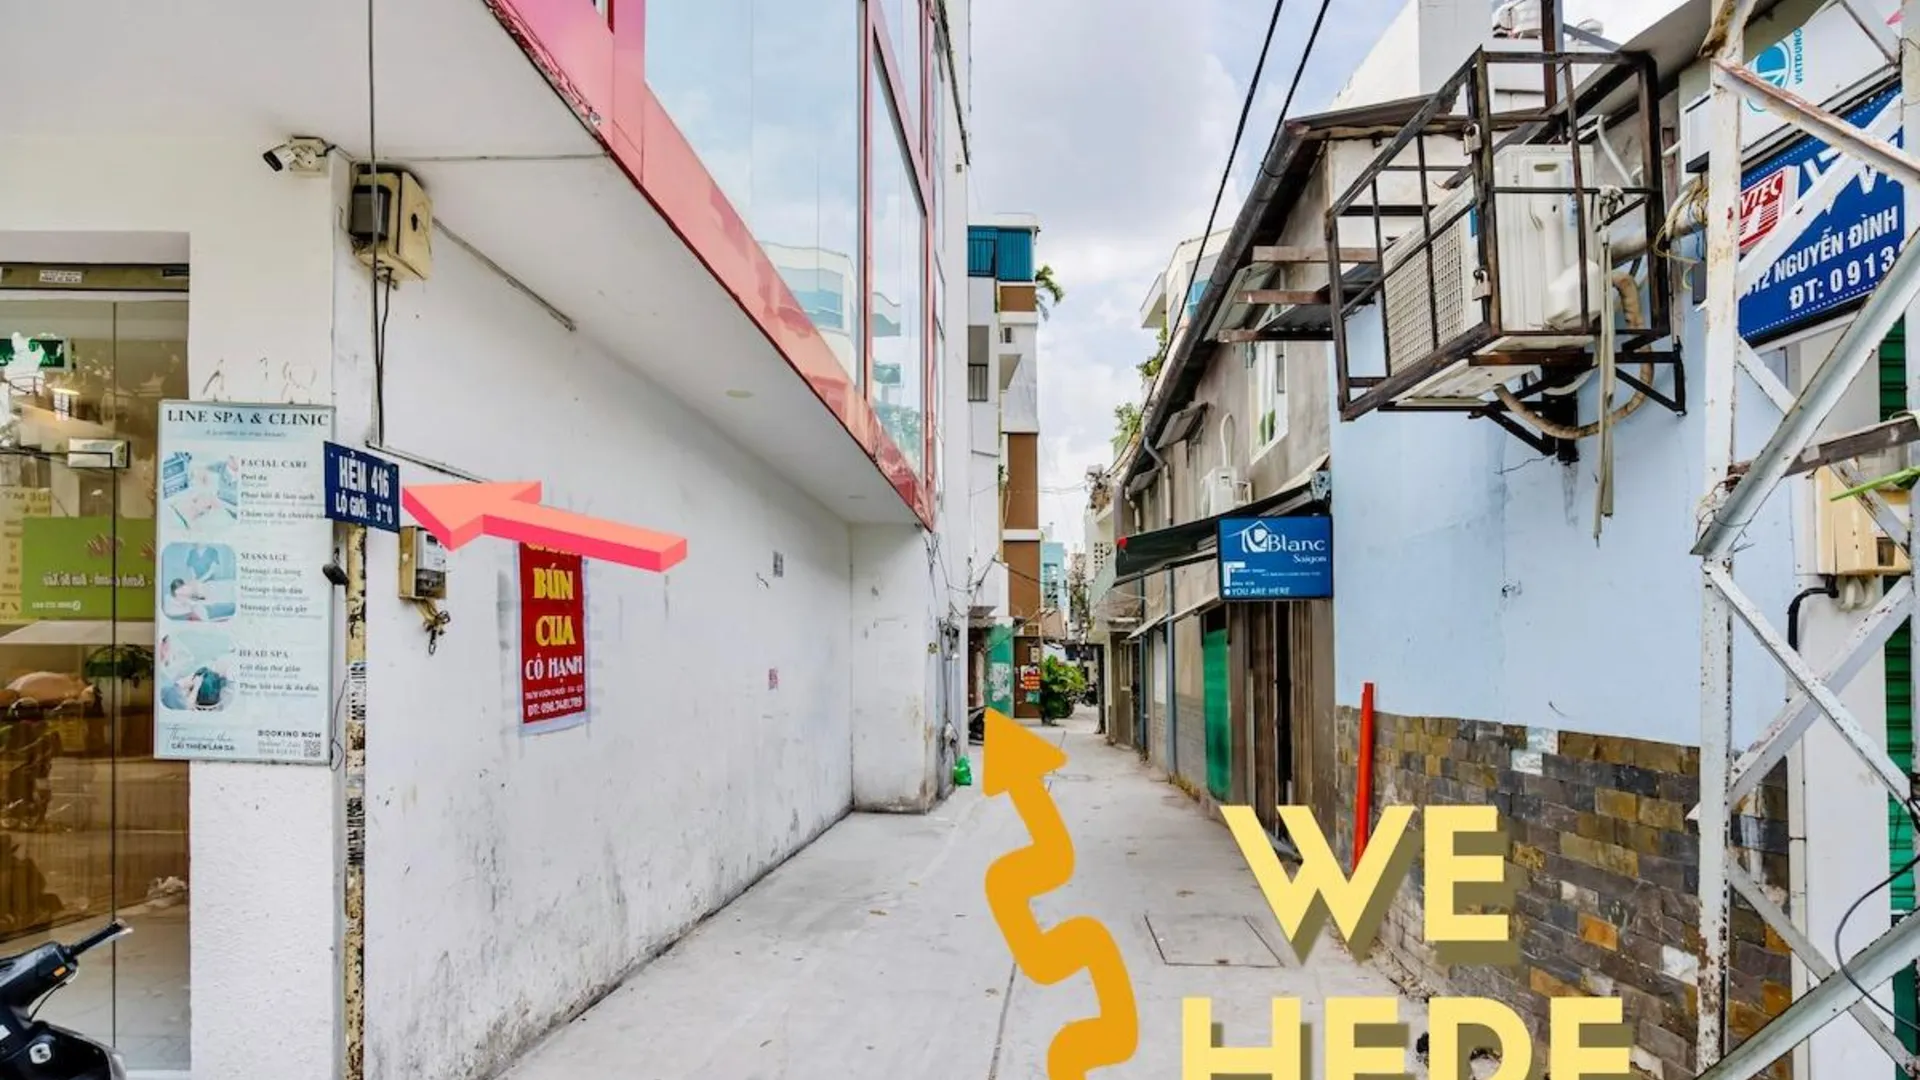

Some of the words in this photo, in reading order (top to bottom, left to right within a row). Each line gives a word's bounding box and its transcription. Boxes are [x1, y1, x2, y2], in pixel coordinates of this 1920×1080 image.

[1774, 226, 1844, 283] NGUYỄN
[1847, 206, 1898, 250] ĐÌNH
[167, 409, 208, 424] LINE
[213, 410, 244, 425] SPA
[250, 412, 263, 425] &
[269, 412, 329, 427] CLINIC
[240, 459, 278, 469] FACIAL
[281, 459, 308, 469] CARE
[338, 450, 368, 494] HẺM
[370, 465, 390, 499] 416
[1267, 533, 1326, 552] Blanc
[1292, 552, 1327, 565] Saigon
[531, 562, 574, 600] BÚN
[1231, 587, 1249, 596] YOU
[1251, 587, 1266, 596] ARE
[1268, 586, 1291, 596] HERE
[535, 615, 577, 647] CUA
[525, 652, 545, 681] CÔ
[548, 655, 583, 684] HẠNH
[257, 729, 299, 739] BOOKING
[301, 730, 322, 740] NOW
